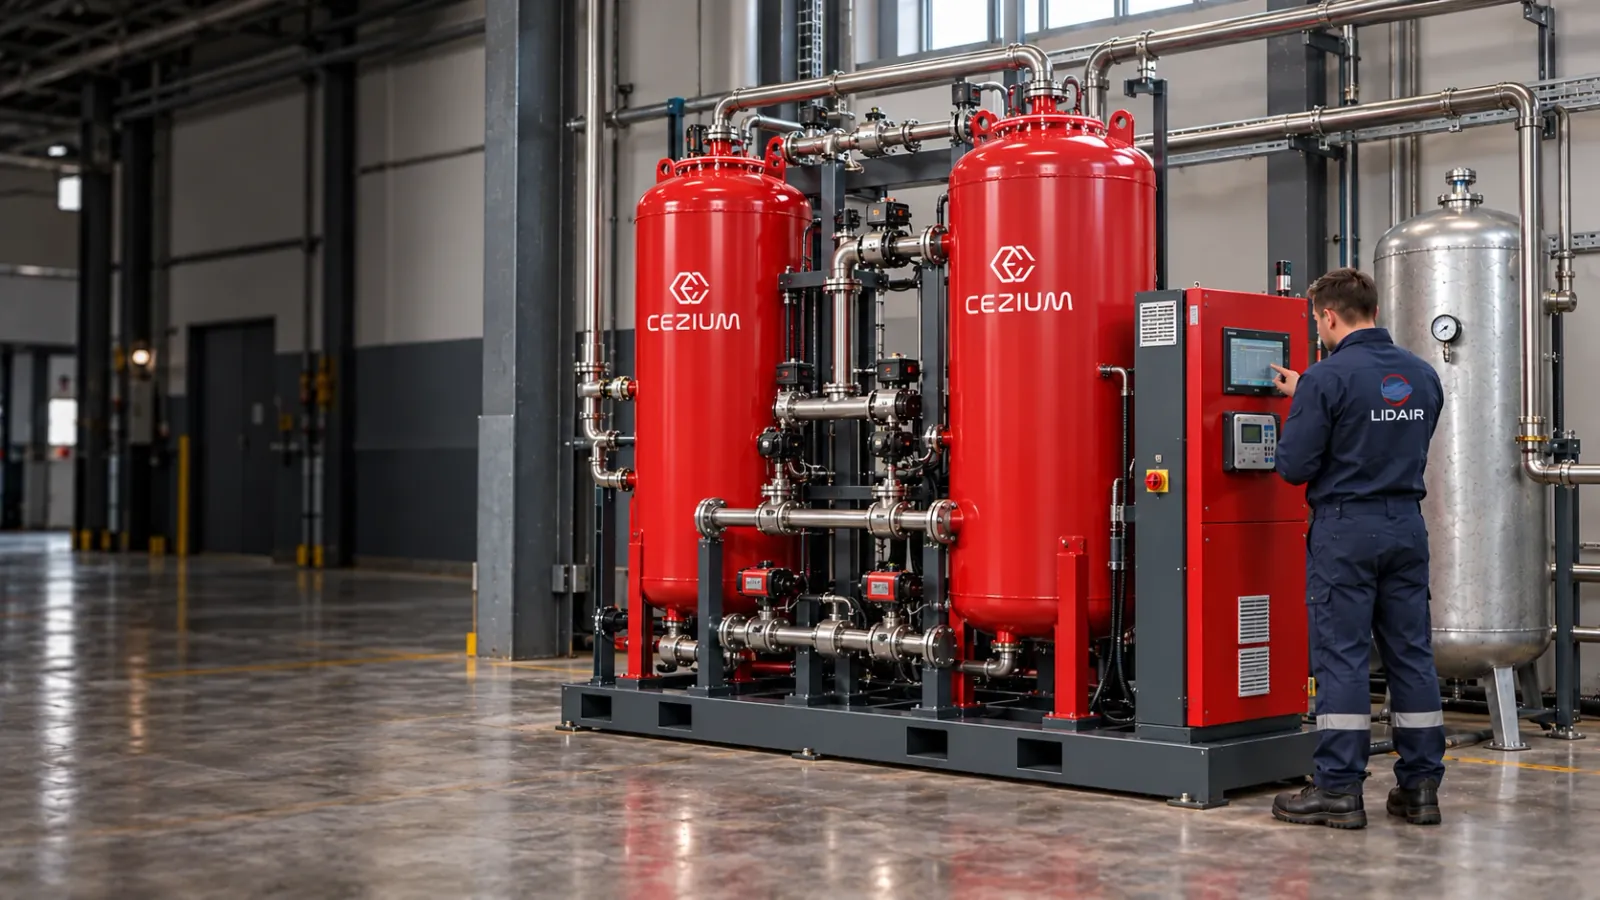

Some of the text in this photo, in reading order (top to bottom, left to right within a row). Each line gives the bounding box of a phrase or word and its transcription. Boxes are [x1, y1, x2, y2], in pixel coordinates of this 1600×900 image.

[965, 291, 1073, 314] CEZIUM
[647, 313, 740, 331] CEZIUM
[1371, 408, 1424, 421] LIDAIR
